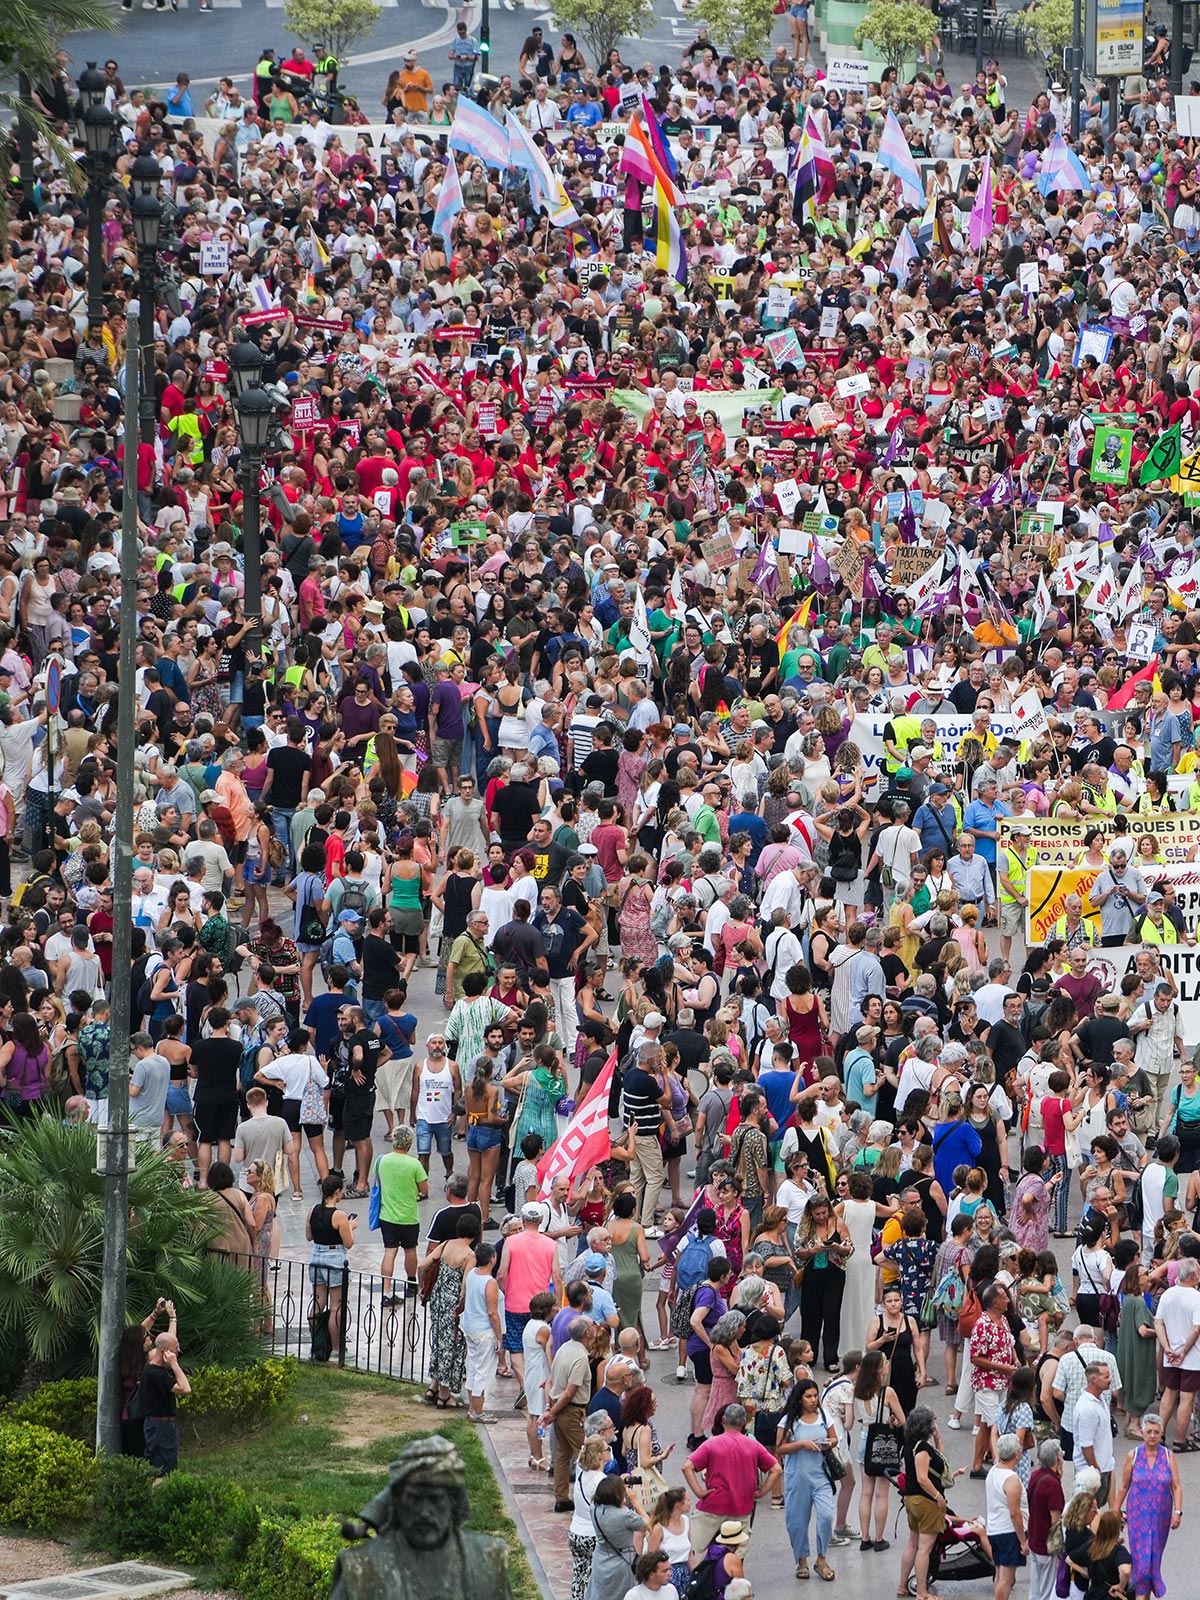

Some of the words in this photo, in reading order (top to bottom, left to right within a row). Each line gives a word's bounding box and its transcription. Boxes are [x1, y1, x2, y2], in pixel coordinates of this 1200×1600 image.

[896, 547, 918, 559] MOLTA
[899, 560, 914, 570] POC
[916, 560, 932, 571] PAR
[1001, 825, 1082, 837] PSIONS
[1178, 834, 1193, 842] DE
